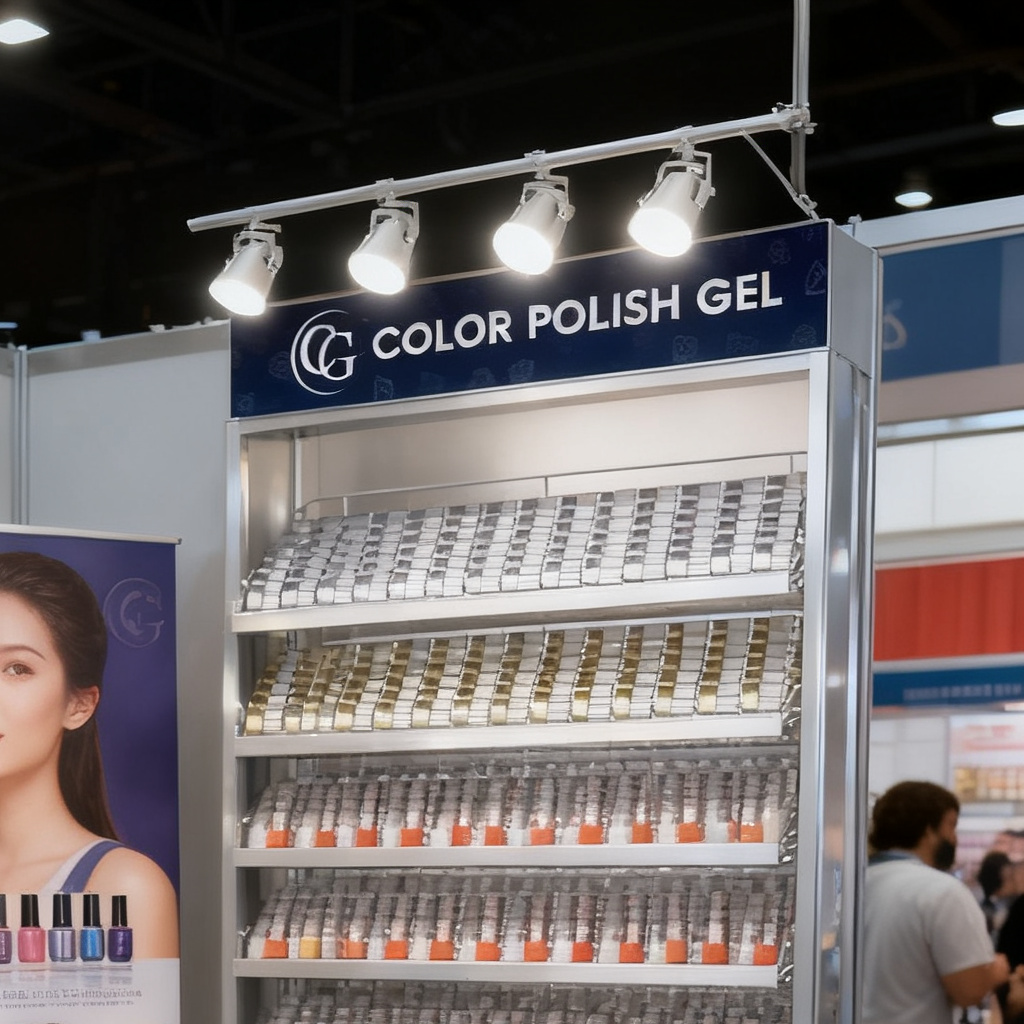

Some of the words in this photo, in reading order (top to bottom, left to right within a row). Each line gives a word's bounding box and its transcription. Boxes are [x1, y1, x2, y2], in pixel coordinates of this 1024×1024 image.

[372, 310, 513, 360] COLOR
[528, 284, 680, 339] POLISH
[696, 271, 783, 315] GEL
